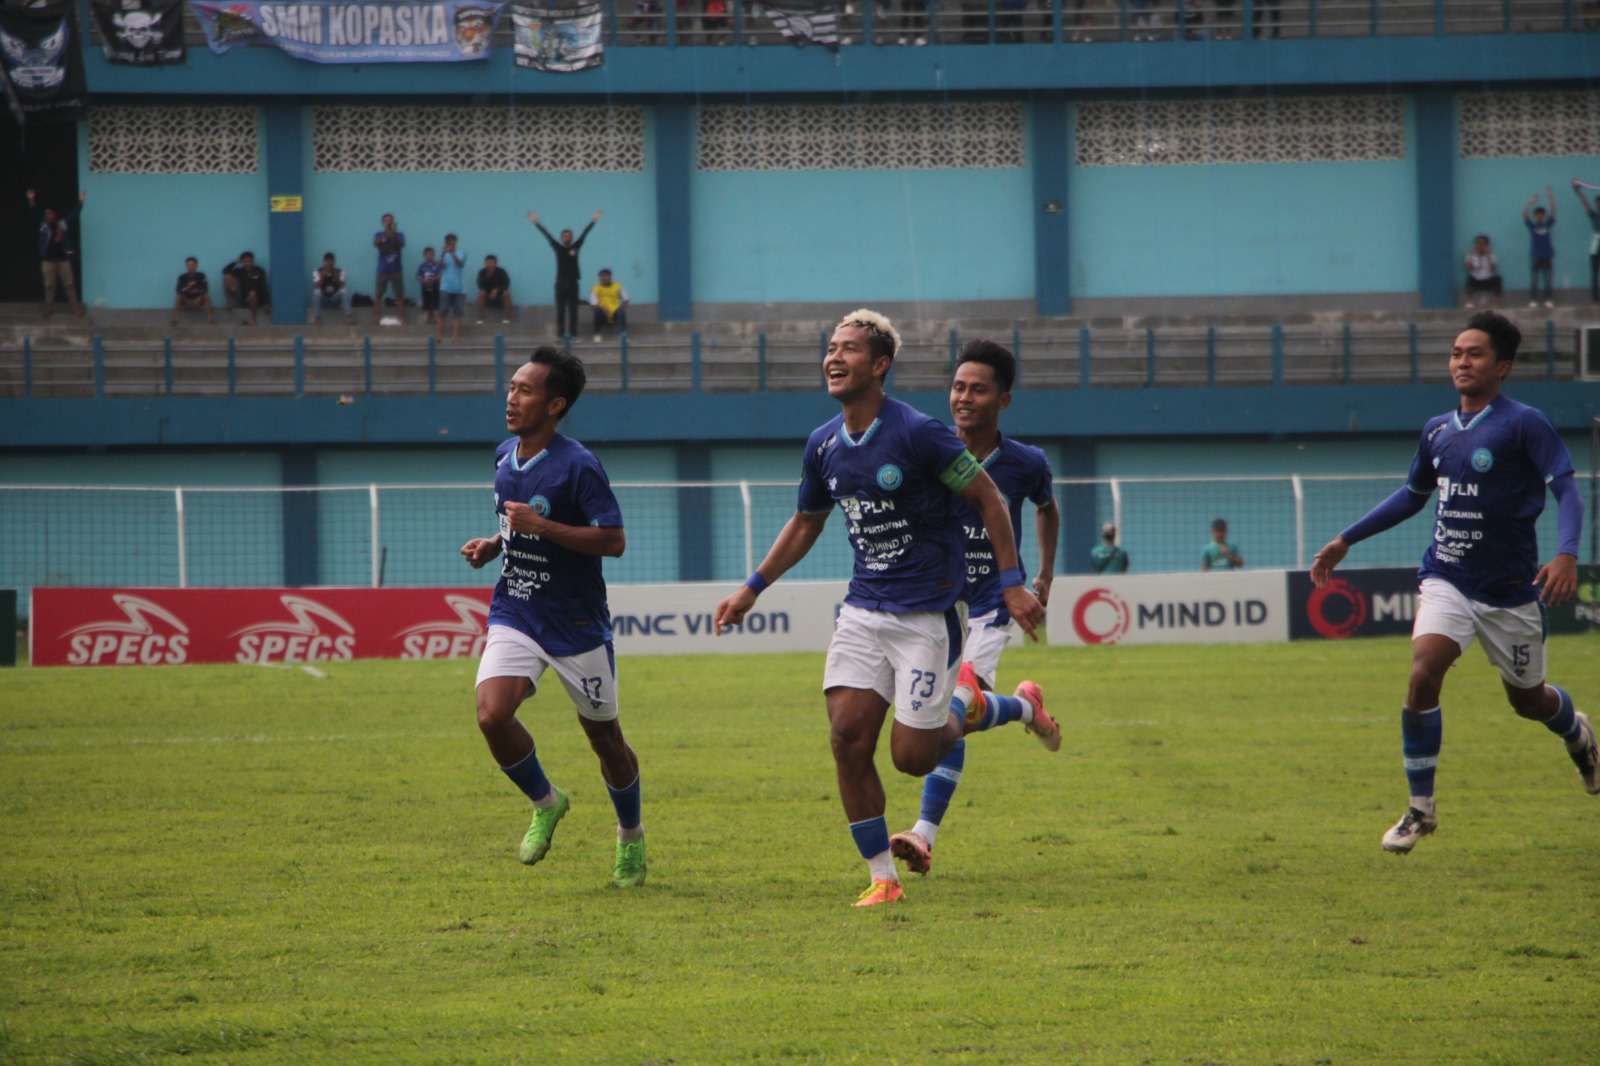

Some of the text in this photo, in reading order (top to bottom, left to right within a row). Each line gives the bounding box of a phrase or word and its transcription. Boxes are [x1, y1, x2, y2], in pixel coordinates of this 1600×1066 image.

[259, 5, 449, 46] SMM KOPASKA
[860, 500, 895, 514] PLN
[863, 519, 909, 534] PERTAMINA
[1446, 528, 1484, 541] MIND ID
[875, 534, 913, 551] MIND ID
[964, 551, 993, 560] AMINA
[513, 565, 551, 582] MIND ID
[1138, 599, 1268, 630] MIND ID
[1372, 593, 1420, 622] MI
[611, 614, 679, 637] MNC
[67, 635, 190, 665] SPECS
[236, 635, 355, 664] SPECS
[400, 634, 488, 660] SPE
[1511, 643, 1531, 667] 15
[580, 676, 603, 701] 17
[910, 668, 937, 699] 73
